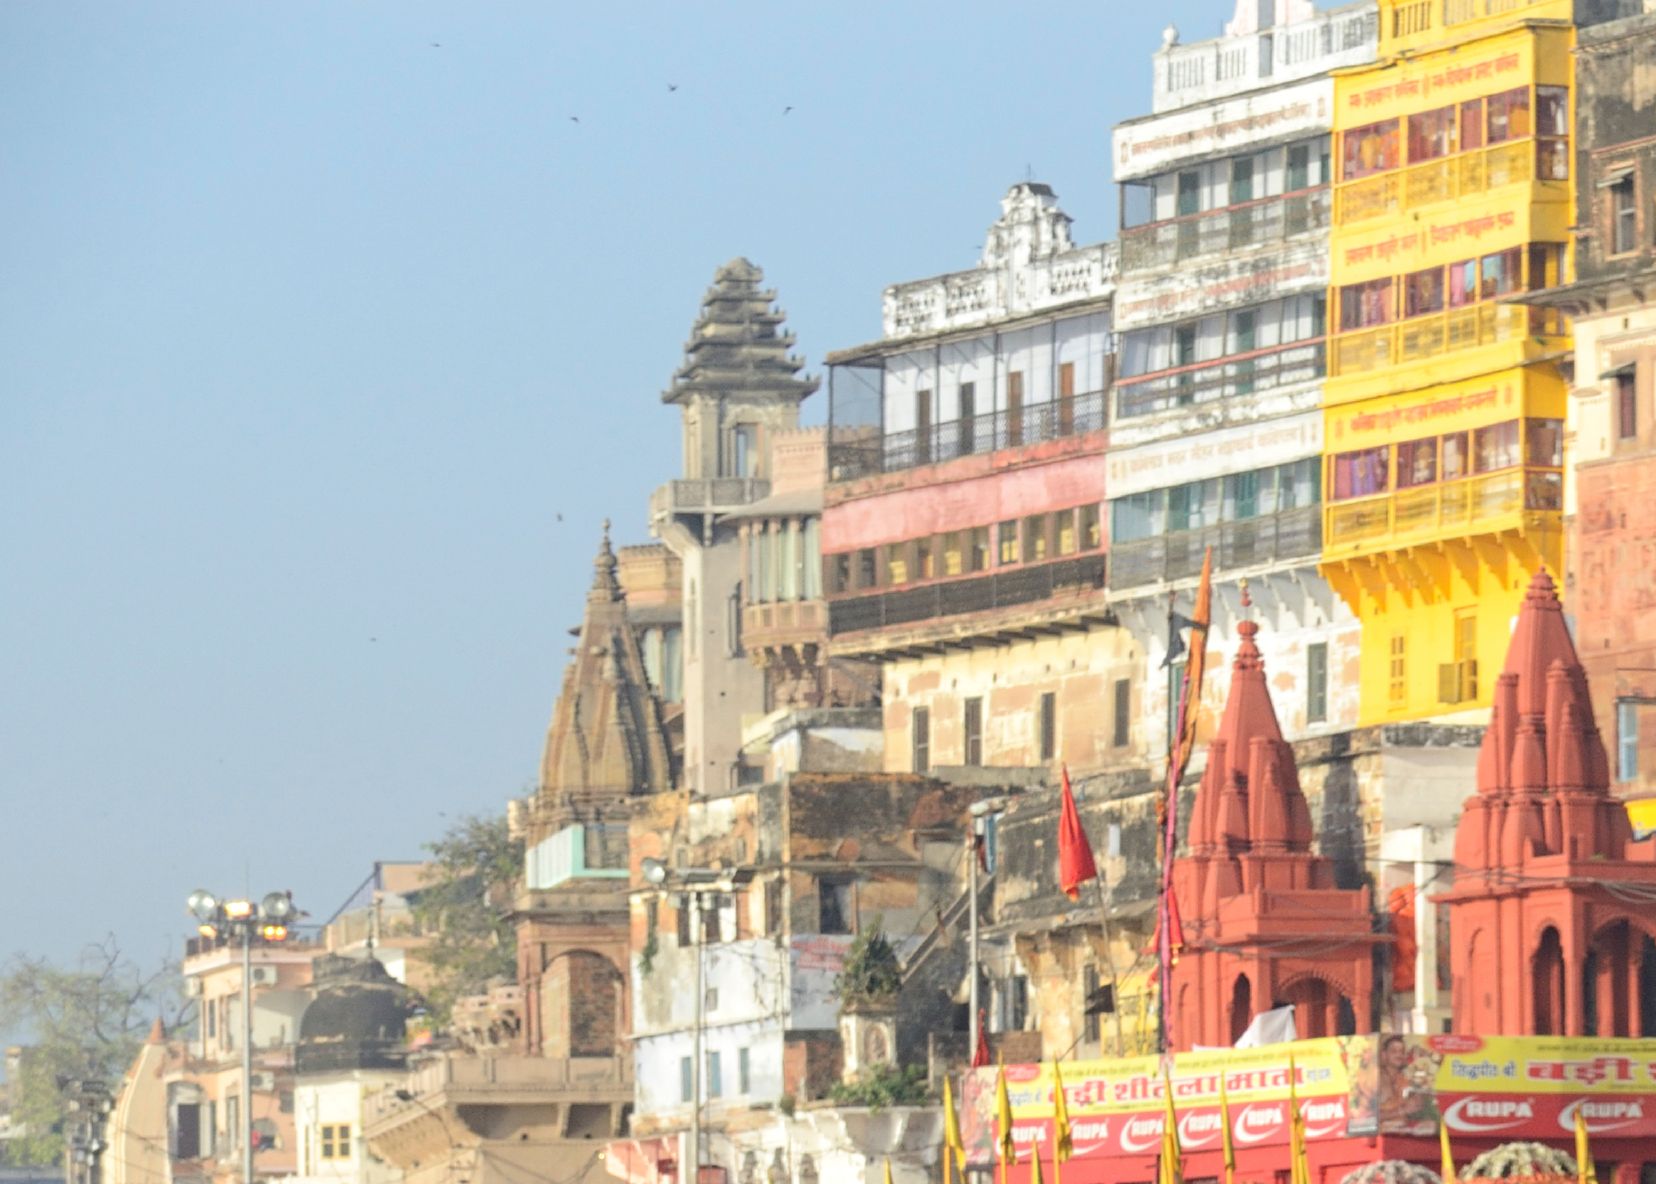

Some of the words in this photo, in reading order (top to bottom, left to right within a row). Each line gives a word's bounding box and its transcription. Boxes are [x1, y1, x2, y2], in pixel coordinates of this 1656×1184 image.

[1072, 1121, 1108, 1140] RUPA
[1131, 1118, 1166, 1136] RUPA
[1188, 1113, 1223, 1132] RUPA
[1247, 1105, 1284, 1126] RUPA
[1307, 1101, 1345, 1121] RUPA
[1466, 1101, 1534, 1118] RUPA
[1580, 1101, 1643, 1118] RUPA
